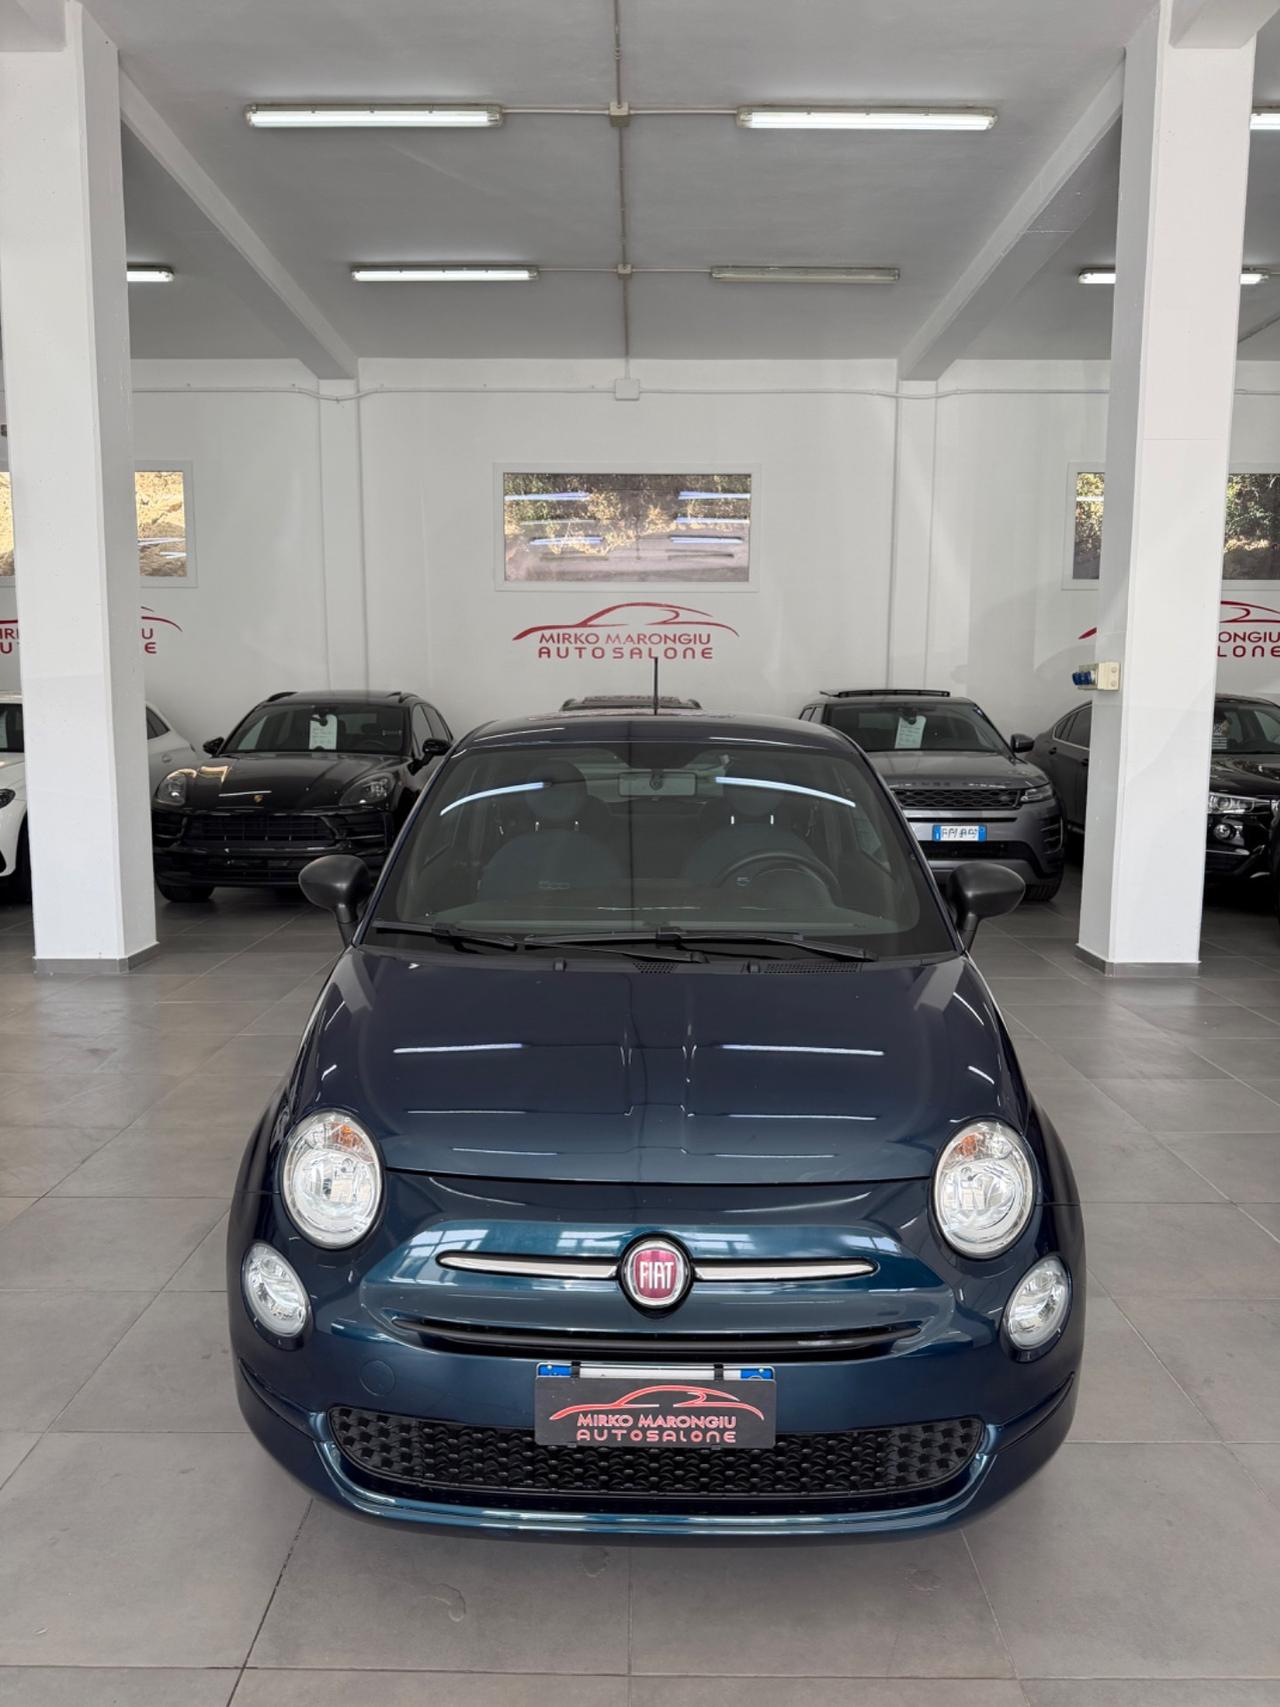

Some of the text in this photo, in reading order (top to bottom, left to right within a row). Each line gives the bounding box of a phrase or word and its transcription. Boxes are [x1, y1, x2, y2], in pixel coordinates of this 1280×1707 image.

[539, 633, 711, 645] MIRKO MARONGIU
[1218, 631, 1280, 643] ONGIU
[538, 646, 713, 659] AUTOSALONE
[639, 1261, 674, 1289] FIAT
[577, 1413, 737, 1429] MIRKO MARONGIU
[576, 1429, 737, 1443] AUTOSALONE
